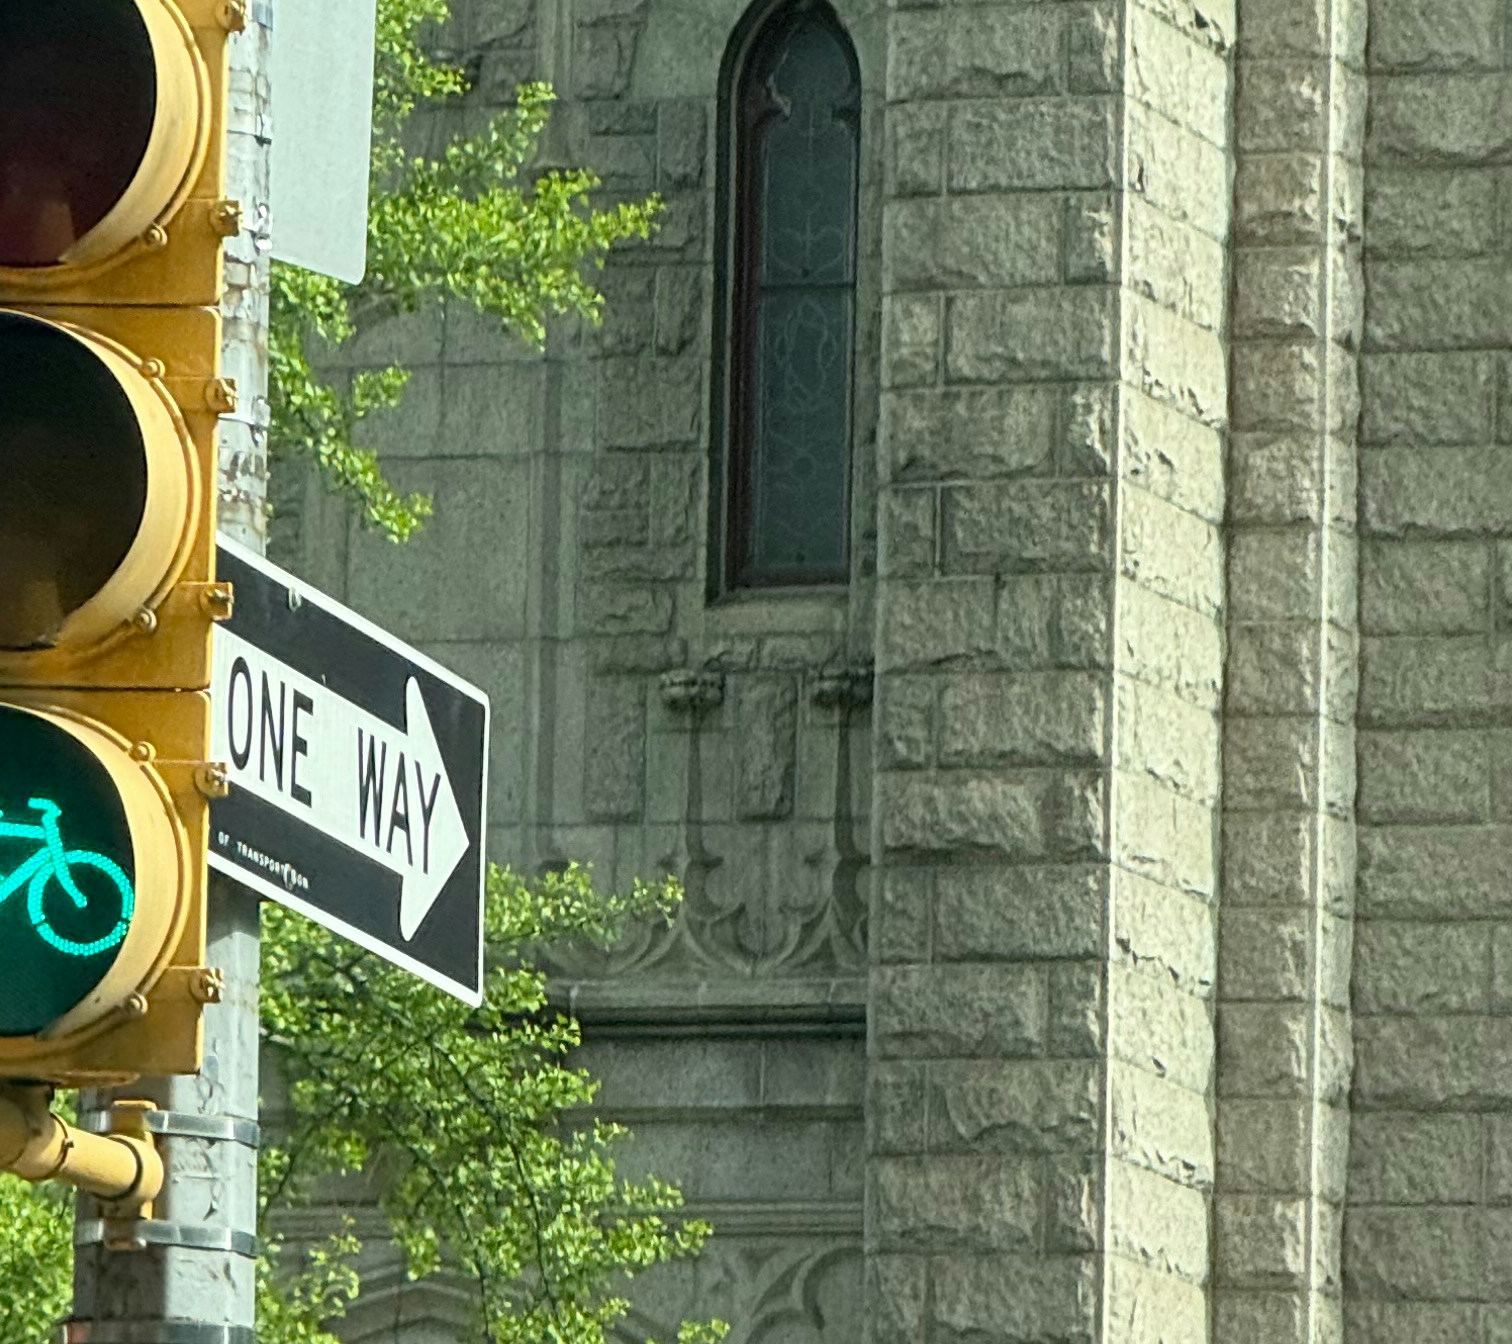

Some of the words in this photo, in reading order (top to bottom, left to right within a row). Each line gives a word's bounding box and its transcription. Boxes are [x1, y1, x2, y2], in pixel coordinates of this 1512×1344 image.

[227, 656, 314, 808] ONE
[358, 726, 442, 875] WAY
[218, 831, 230, 846] OF
